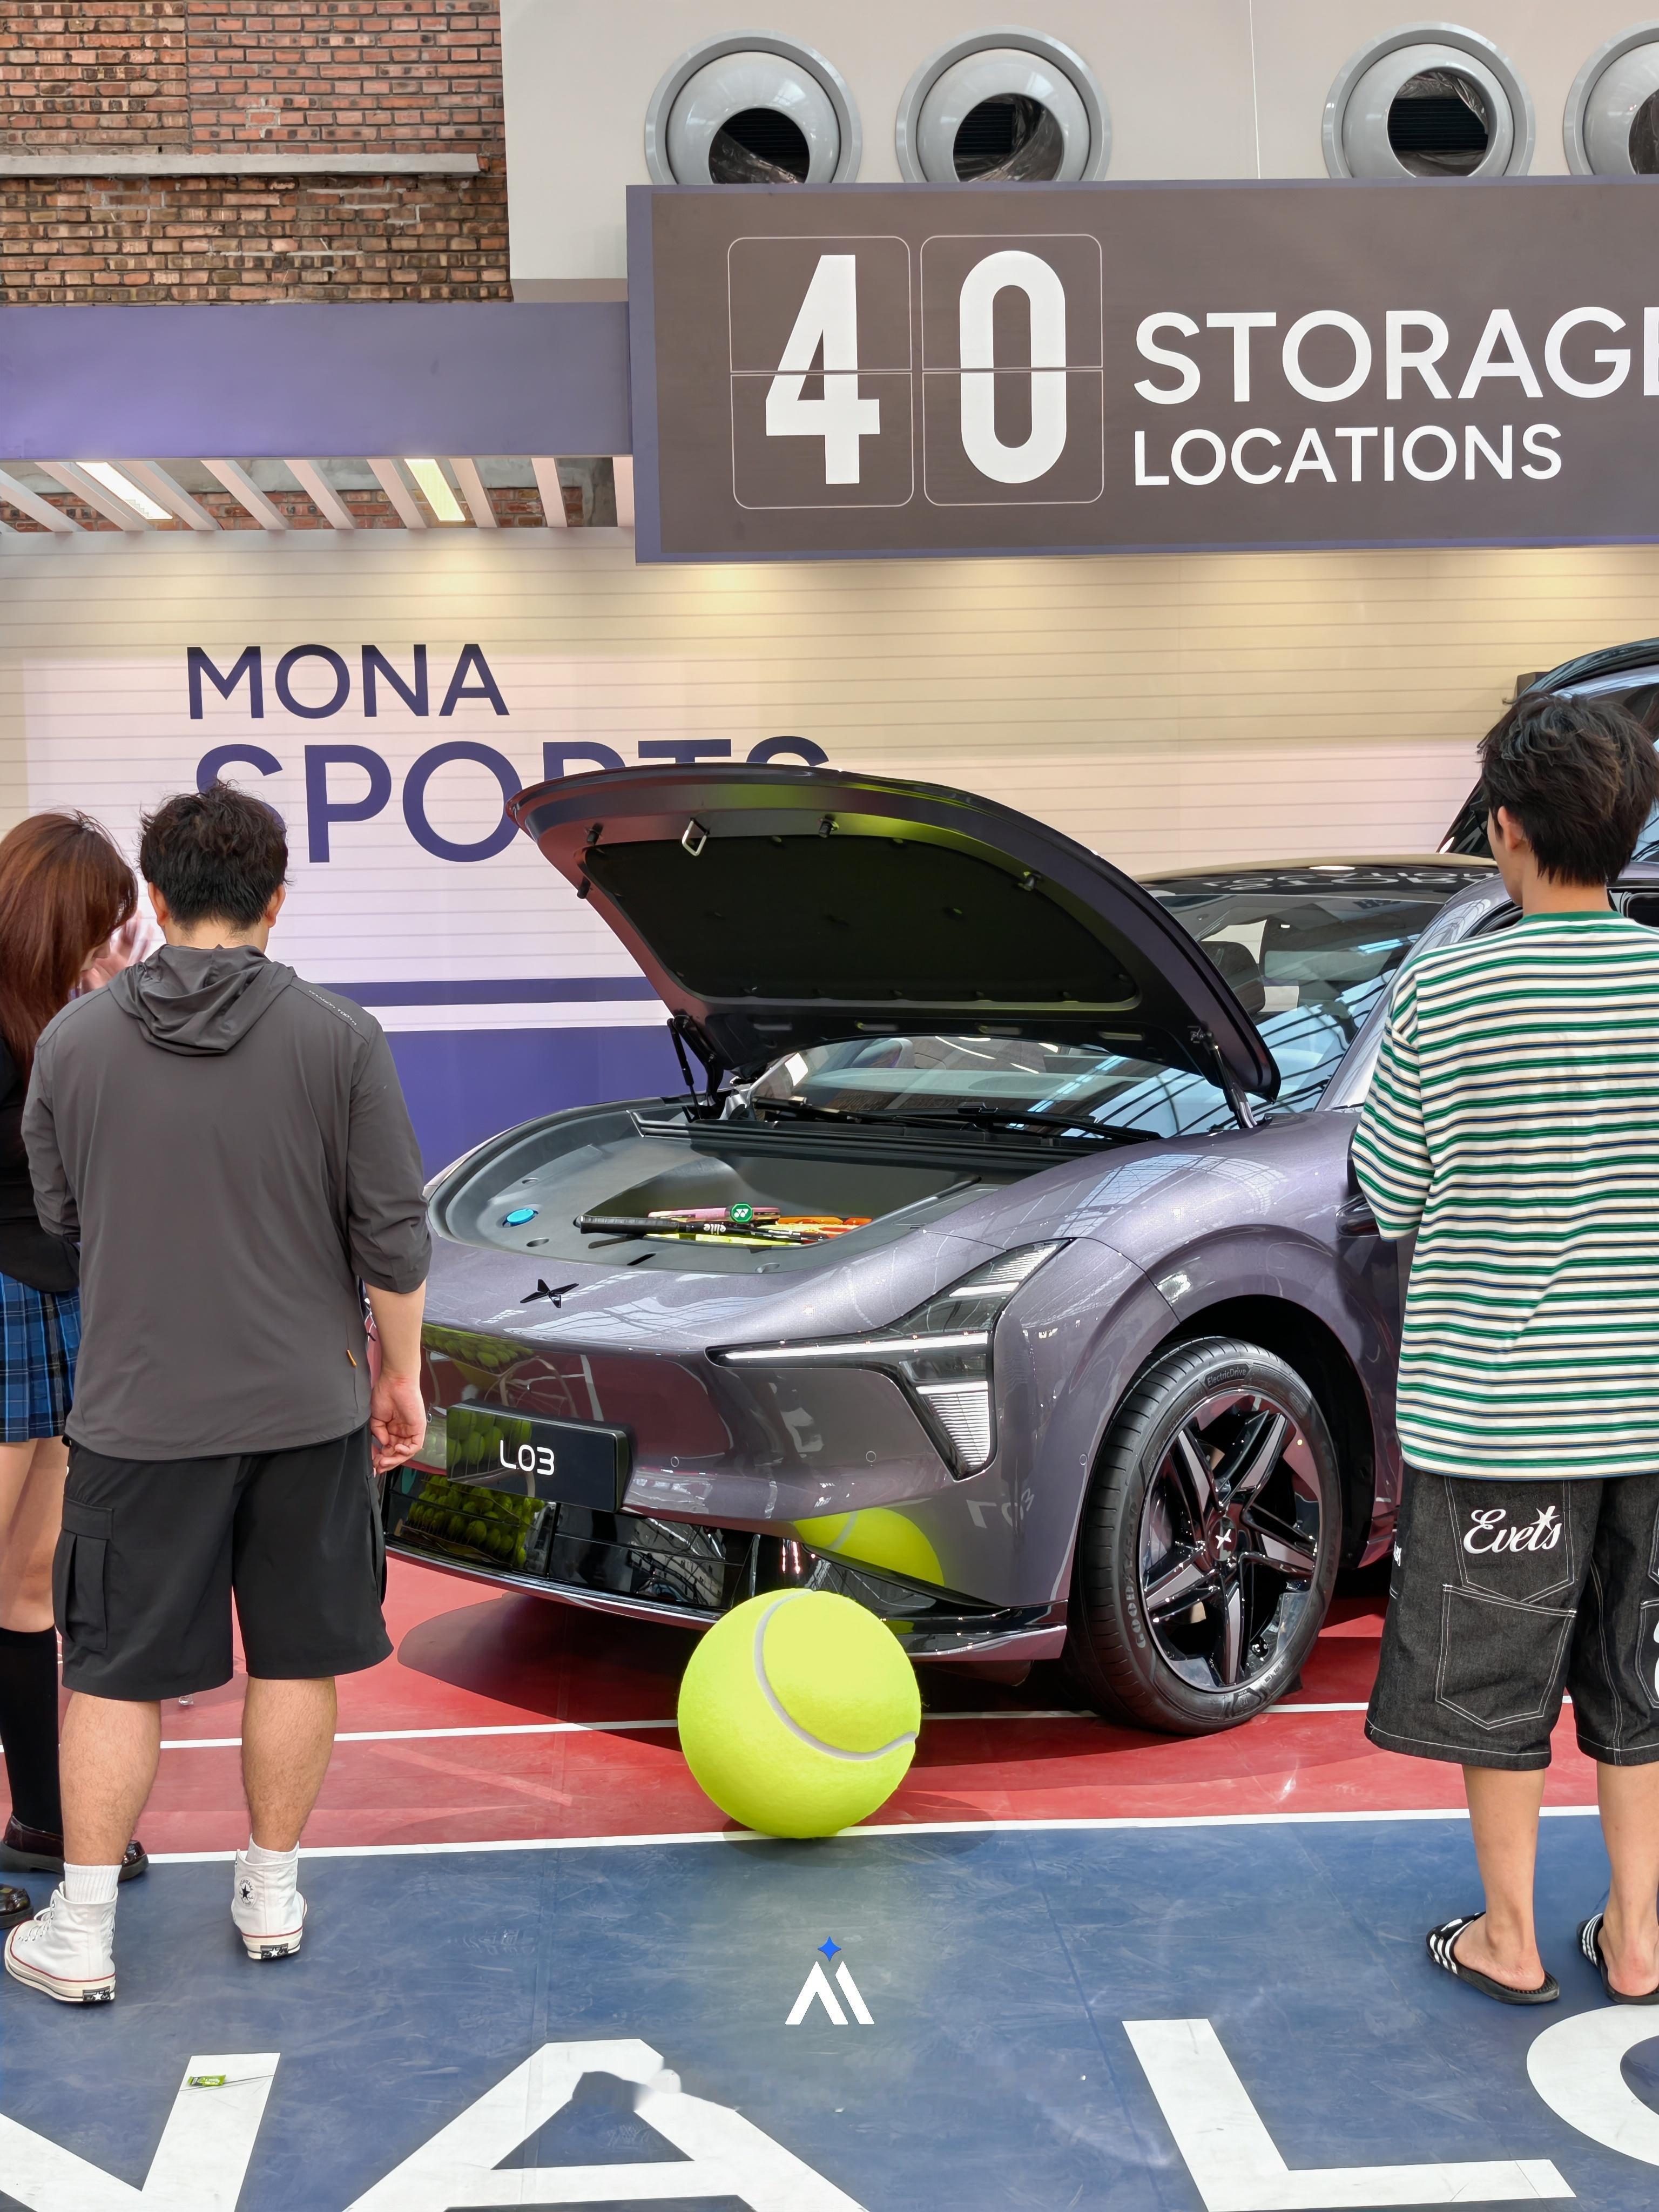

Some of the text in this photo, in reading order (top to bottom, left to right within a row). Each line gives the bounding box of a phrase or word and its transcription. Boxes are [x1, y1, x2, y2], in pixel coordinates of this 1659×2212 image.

[765, 249, 1067, 485] 40
[1134, 306, 1659, 405] STORAG
[1135, 423, 1562, 486] LOCATIONS
[187, 644, 510, 719] MONA
[196, 736, 830, 863] SPO
[1207, 1367, 1246, 1386] ElectricDrive
[1463, 1506, 1562, 1554] Evets
